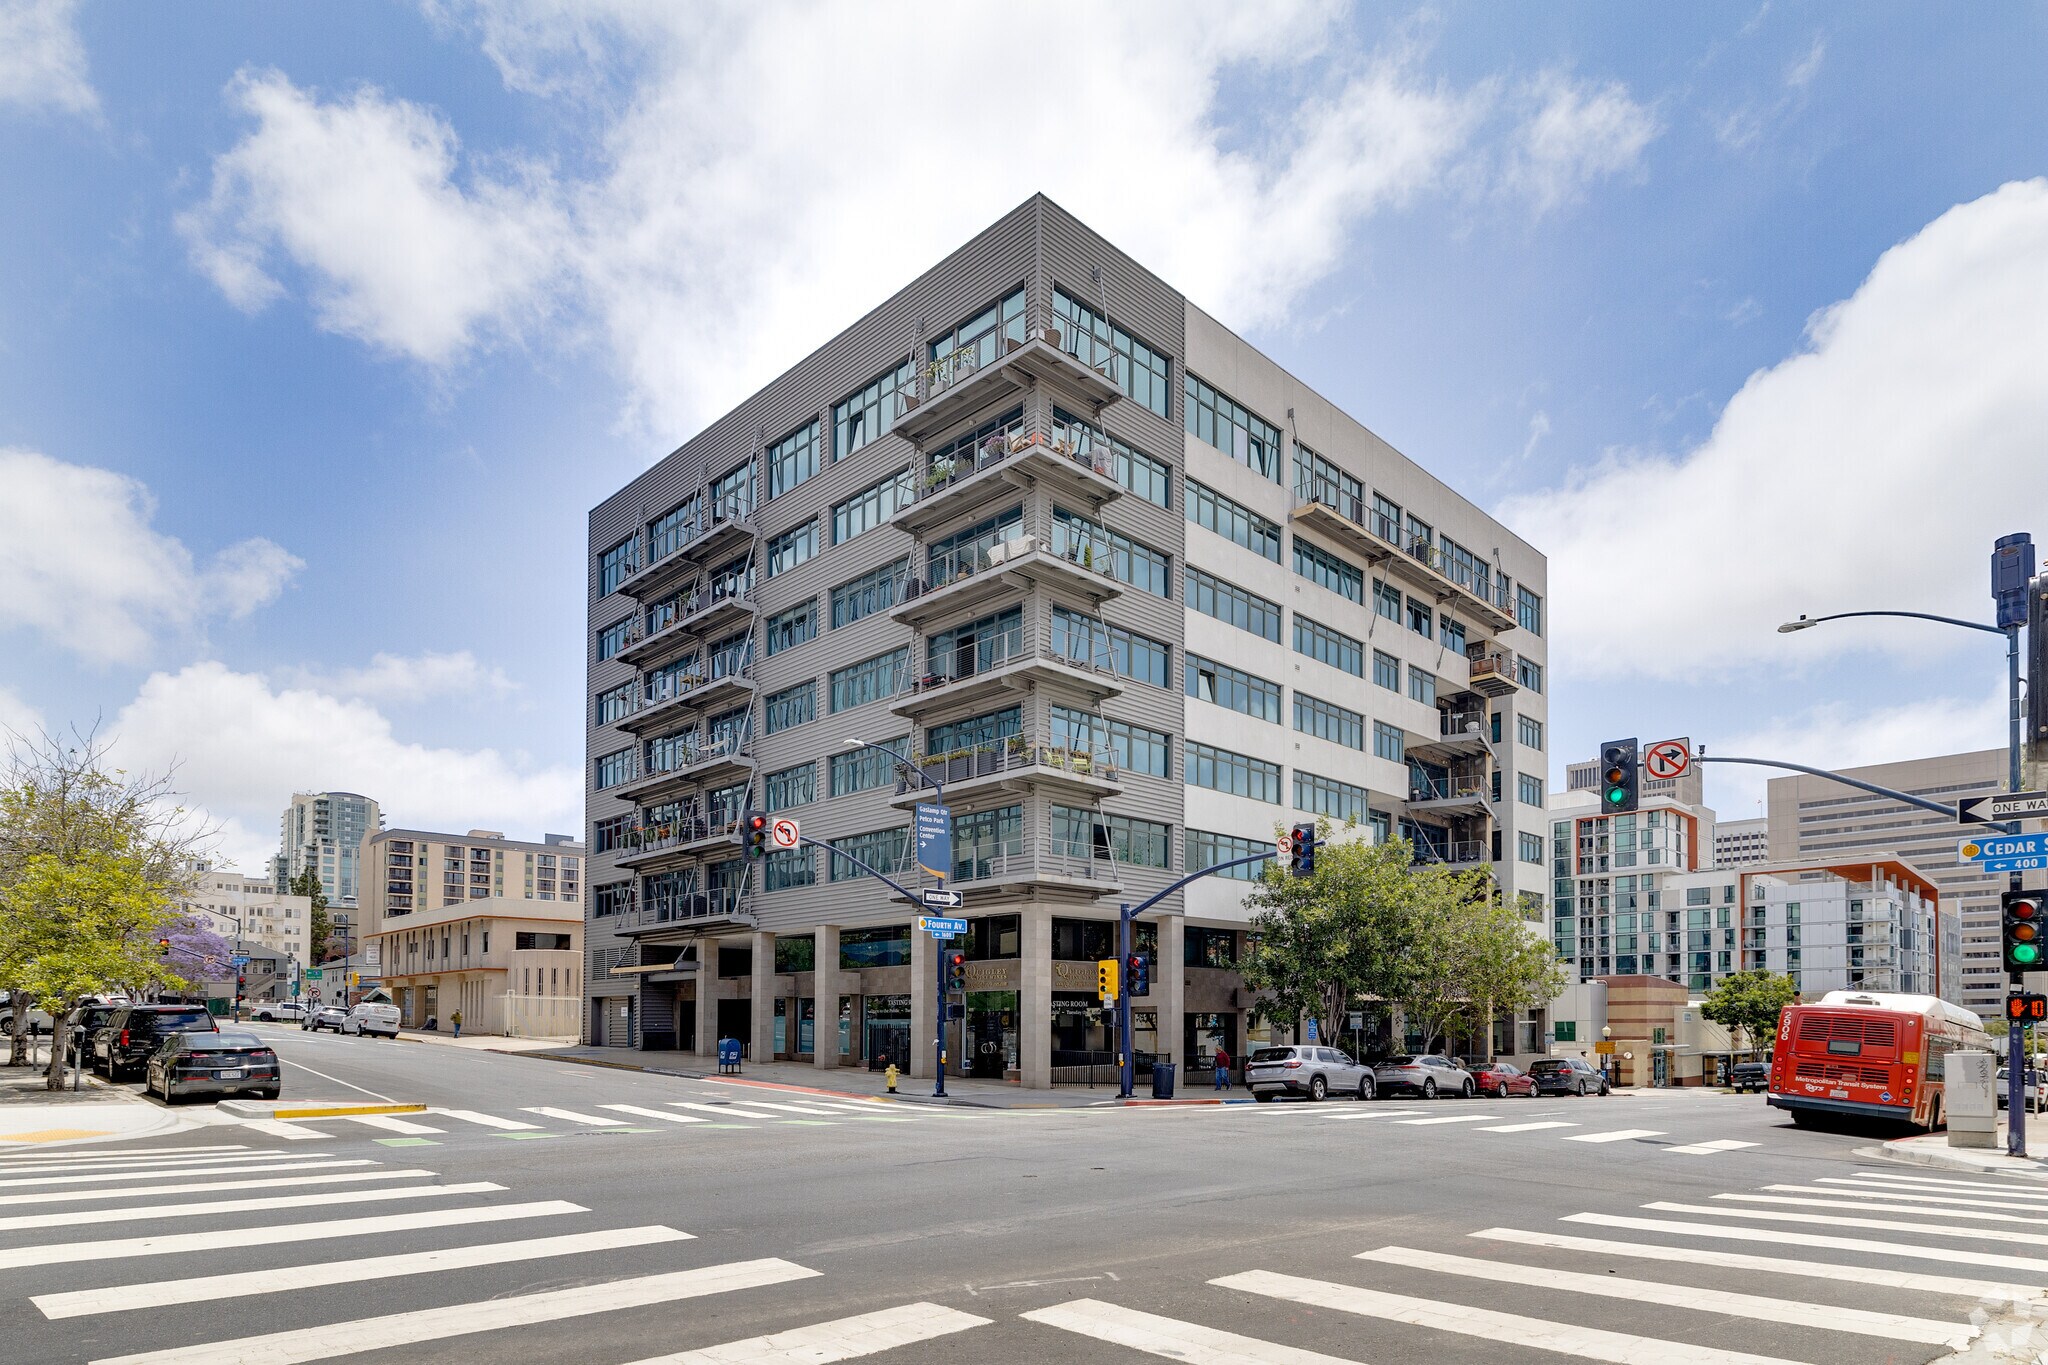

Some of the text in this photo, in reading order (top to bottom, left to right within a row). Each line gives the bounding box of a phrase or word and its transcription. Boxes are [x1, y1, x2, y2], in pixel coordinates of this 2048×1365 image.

[919, 806, 939, 815] Gaslamp
[1992, 800, 2048, 813] ONE WA
[919, 825, 945, 834] Convention
[919, 832, 935, 840] Center
[1983, 841, 2036, 856] CEDAR
[2014, 858, 2038, 869] 400
[928, 919, 952, 930] FOURTH
[964, 963, 1008, 980] QUIGLEY
[2031, 1000, 2044, 1017] 10
[1781, 1011, 1792, 1041] 2906
[1795, 1076, 1888, 1091] Metropolitan Transit System
